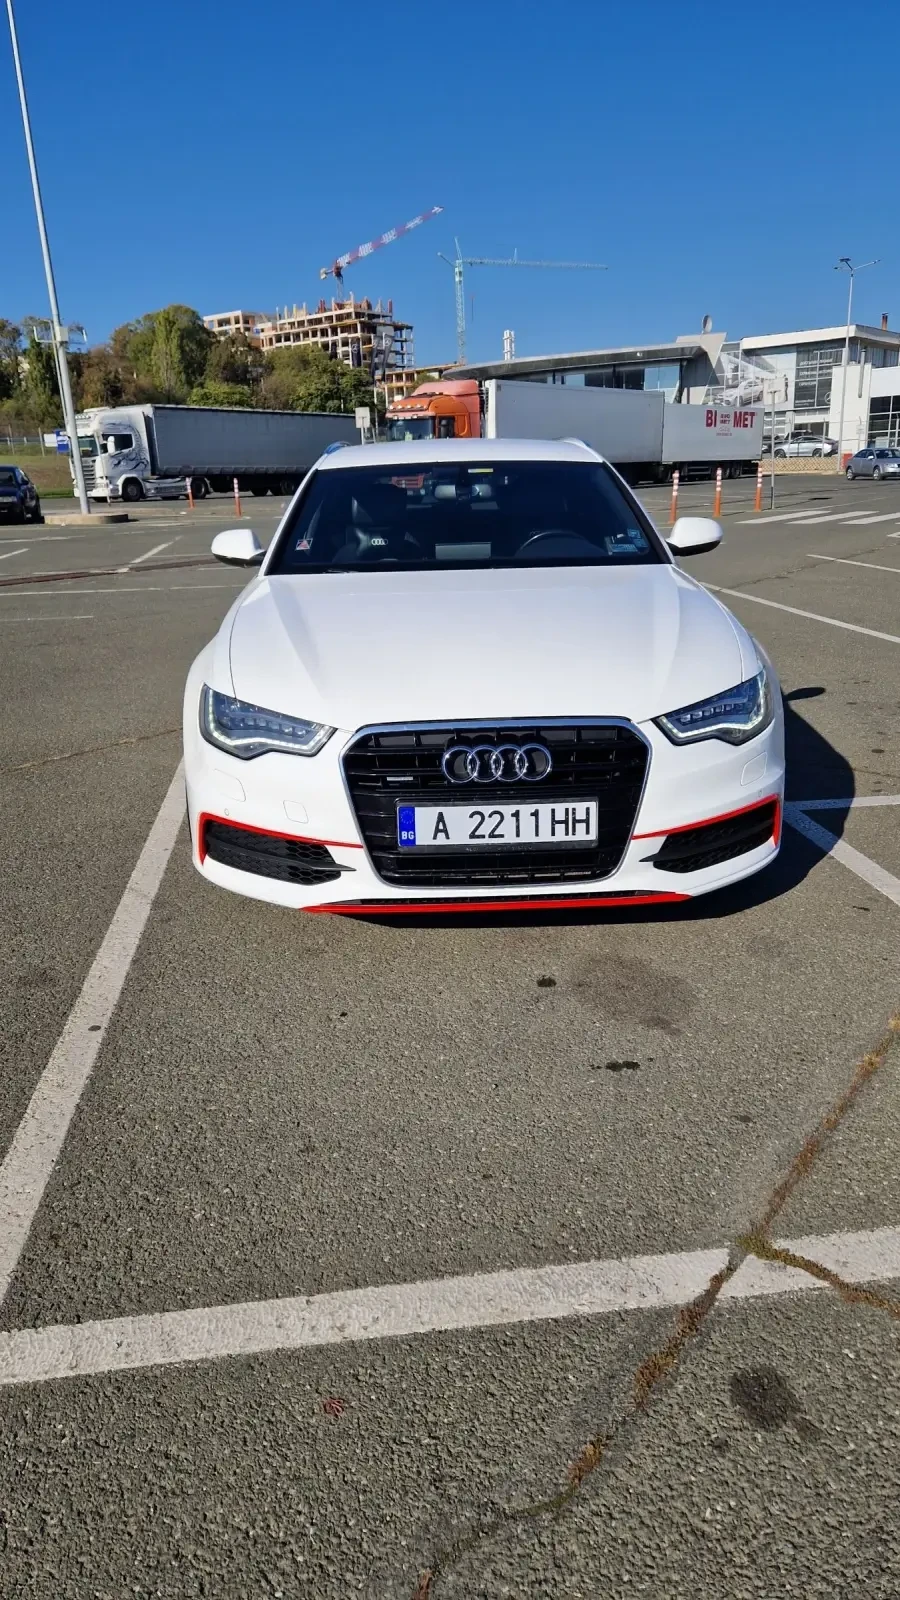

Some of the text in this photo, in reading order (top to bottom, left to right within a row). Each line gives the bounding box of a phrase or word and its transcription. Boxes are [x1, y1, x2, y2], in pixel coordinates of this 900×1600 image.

[705, 409, 755, 429] BI MET
[401, 831, 415, 840] BG
[432, 811, 450, 840] A
